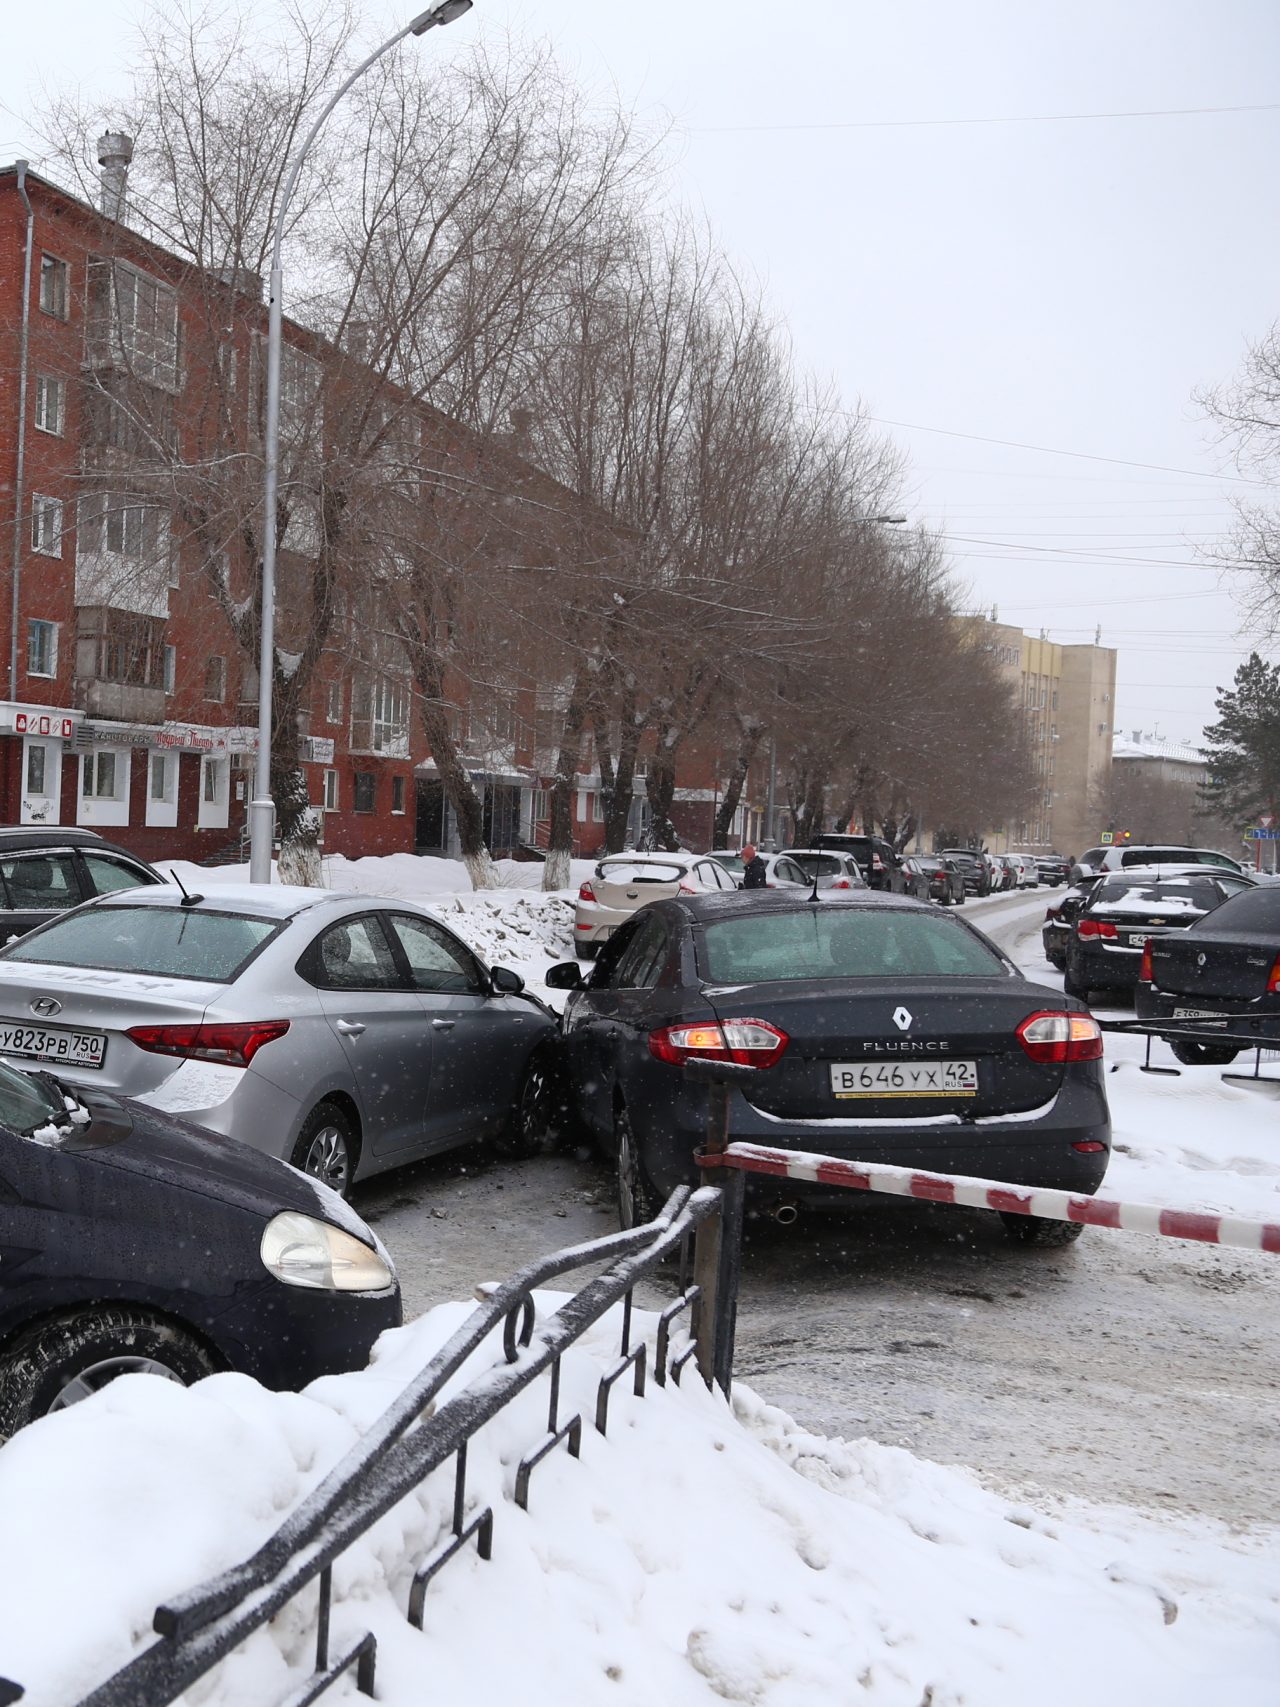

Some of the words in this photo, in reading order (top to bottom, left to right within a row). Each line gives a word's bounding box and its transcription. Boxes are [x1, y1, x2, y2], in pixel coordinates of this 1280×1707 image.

[3, 1029, 68, 1054] У823РВ
[72, 1035, 99, 1053] 750
[863, 1041, 950, 1051] FLUENCE
[841, 1066, 939, 1089] В646УХ
[946, 1063, 969, 1080] 42
